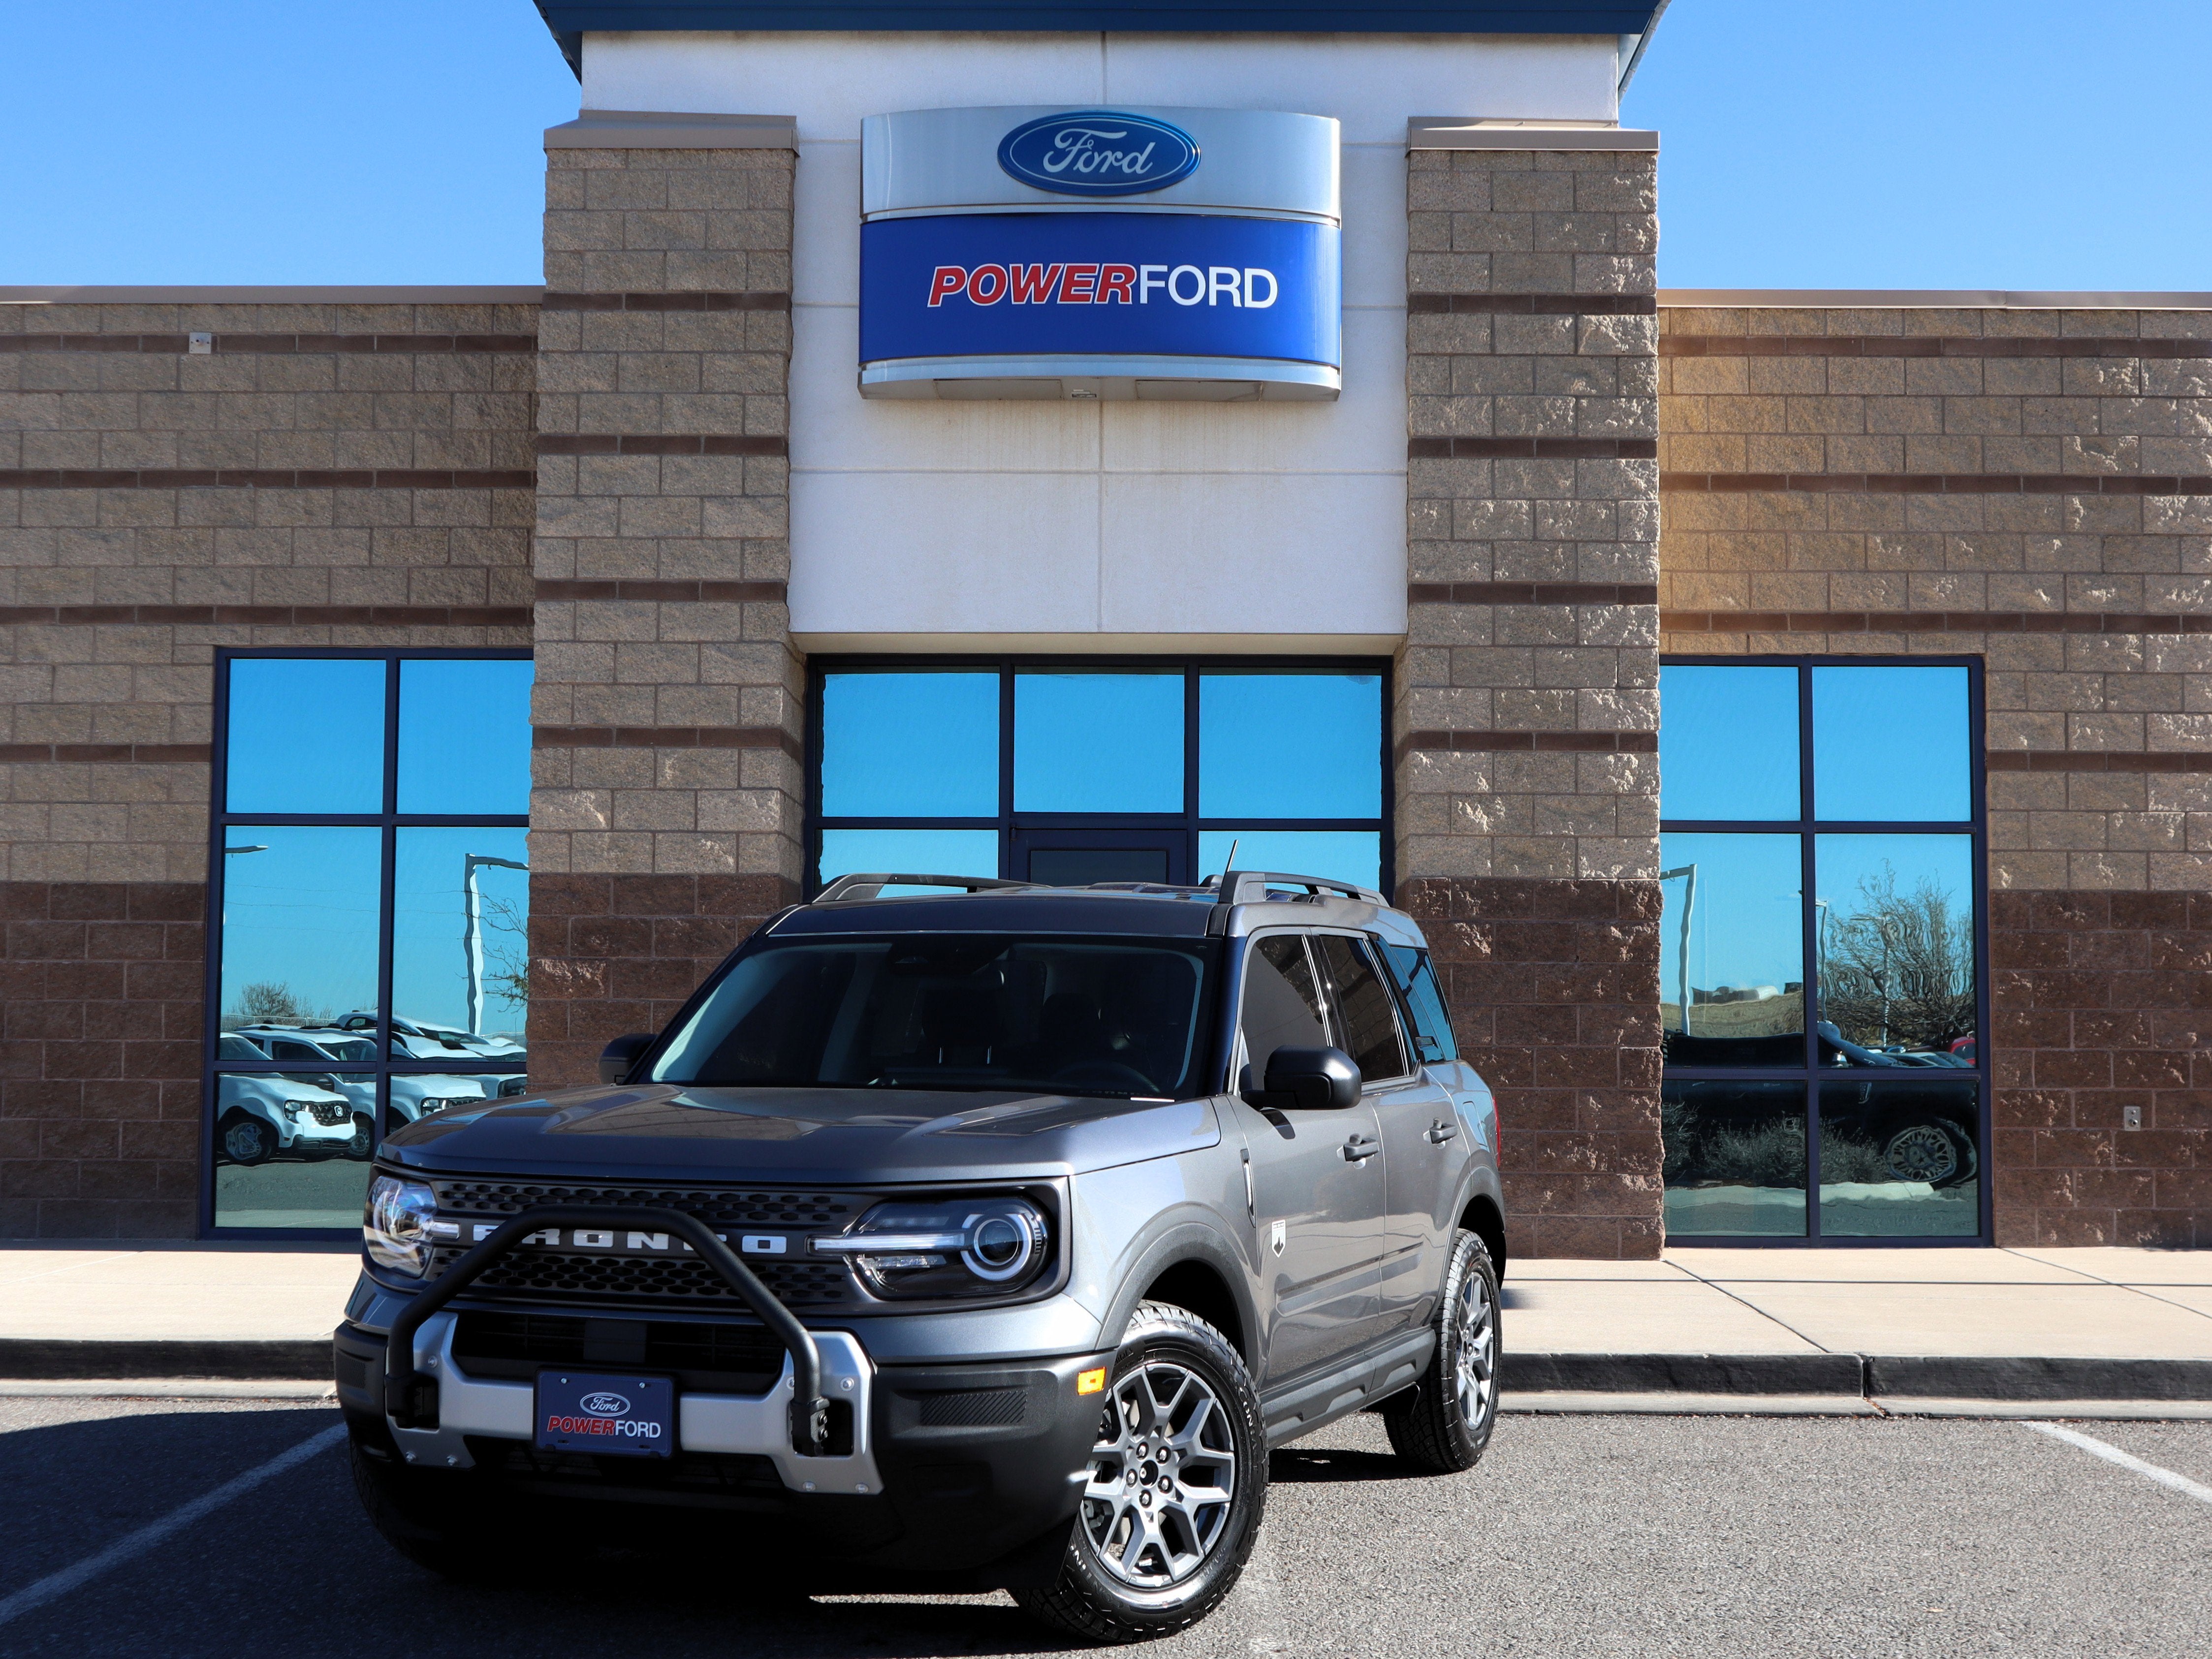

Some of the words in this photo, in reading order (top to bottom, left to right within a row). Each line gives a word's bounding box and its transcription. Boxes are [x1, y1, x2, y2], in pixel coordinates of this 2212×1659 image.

[1043, 128, 1156, 174] Ford
[927, 262, 1278, 309] POWERFORD
[473, 1224, 787, 1254] RONO
[590, 1396, 620, 1412] Ford
[547, 1415, 661, 1438] POWERFORD
